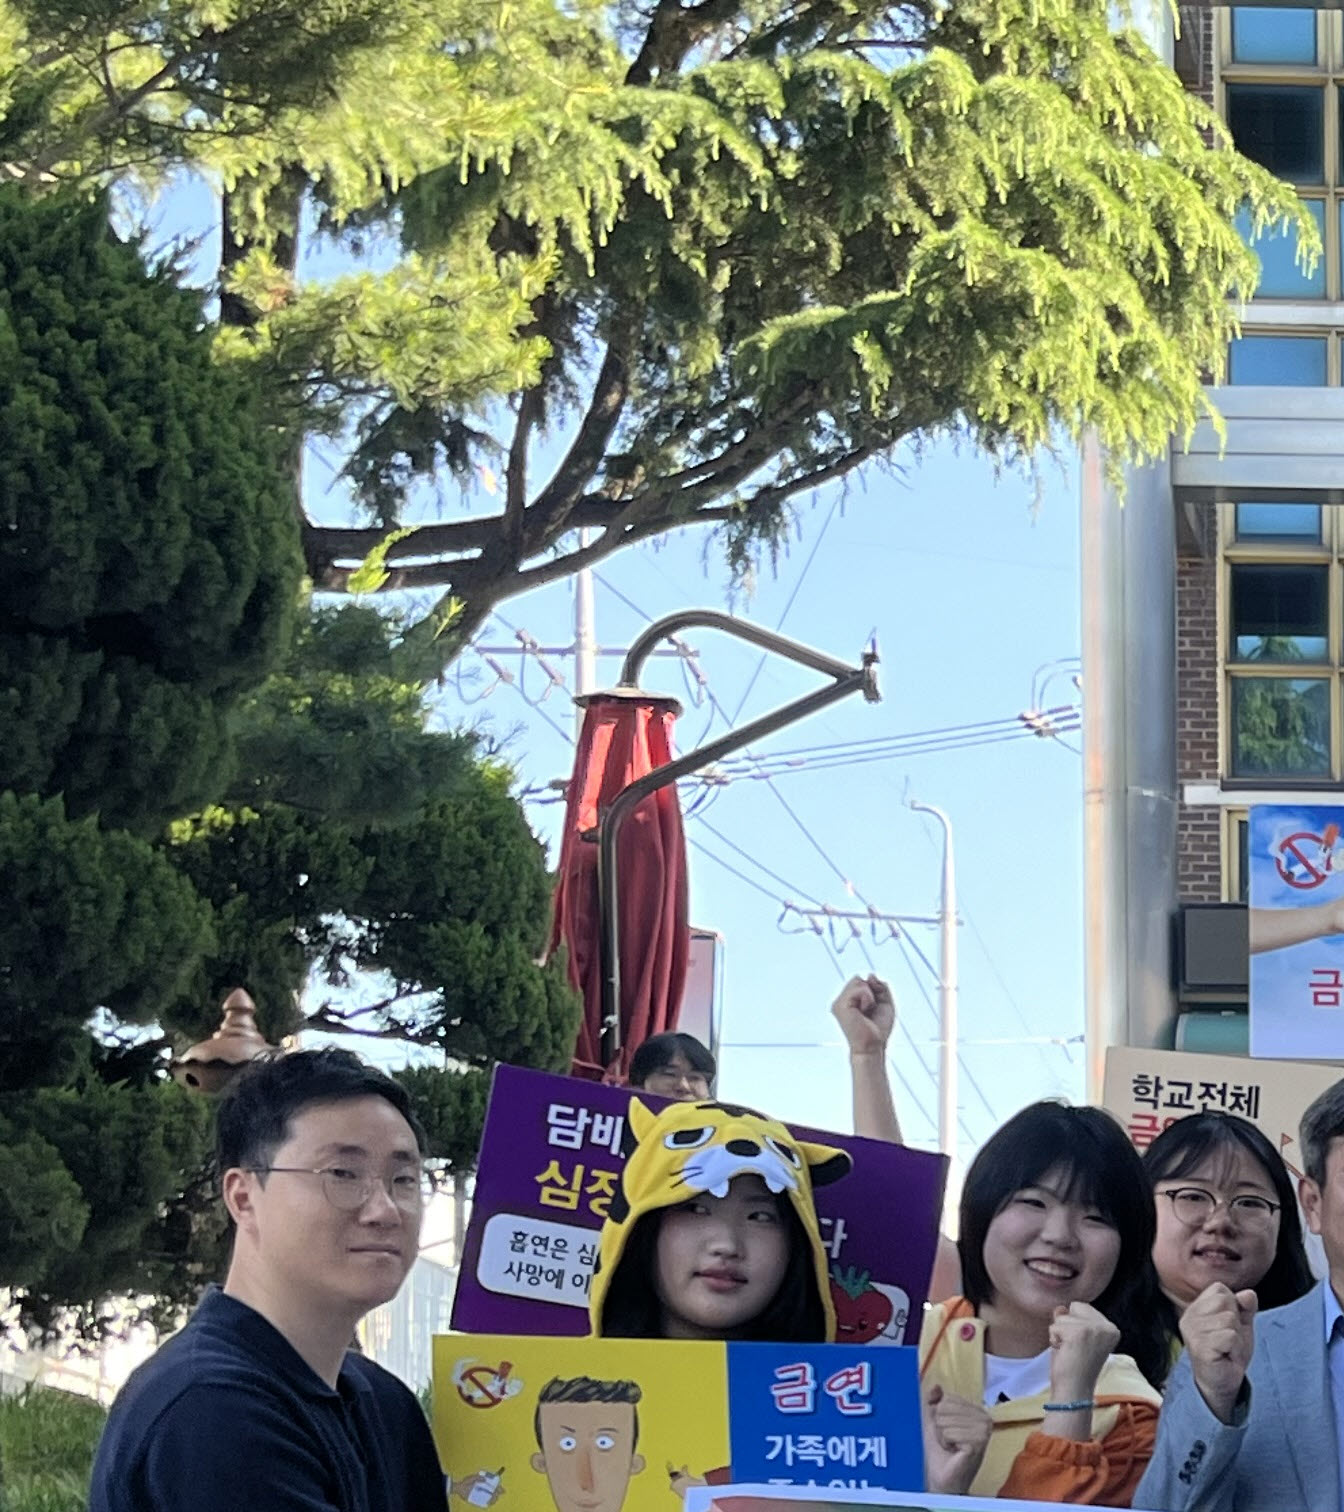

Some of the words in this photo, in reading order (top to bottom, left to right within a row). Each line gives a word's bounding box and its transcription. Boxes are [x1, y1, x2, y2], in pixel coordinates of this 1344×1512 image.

[1132, 1074, 1261, 1119] 학교전체
[509, 1230, 570, 1262] 흡연은
[503, 1261, 565, 1291] 사망에
[765, 1434, 888, 1468] 가족에게
